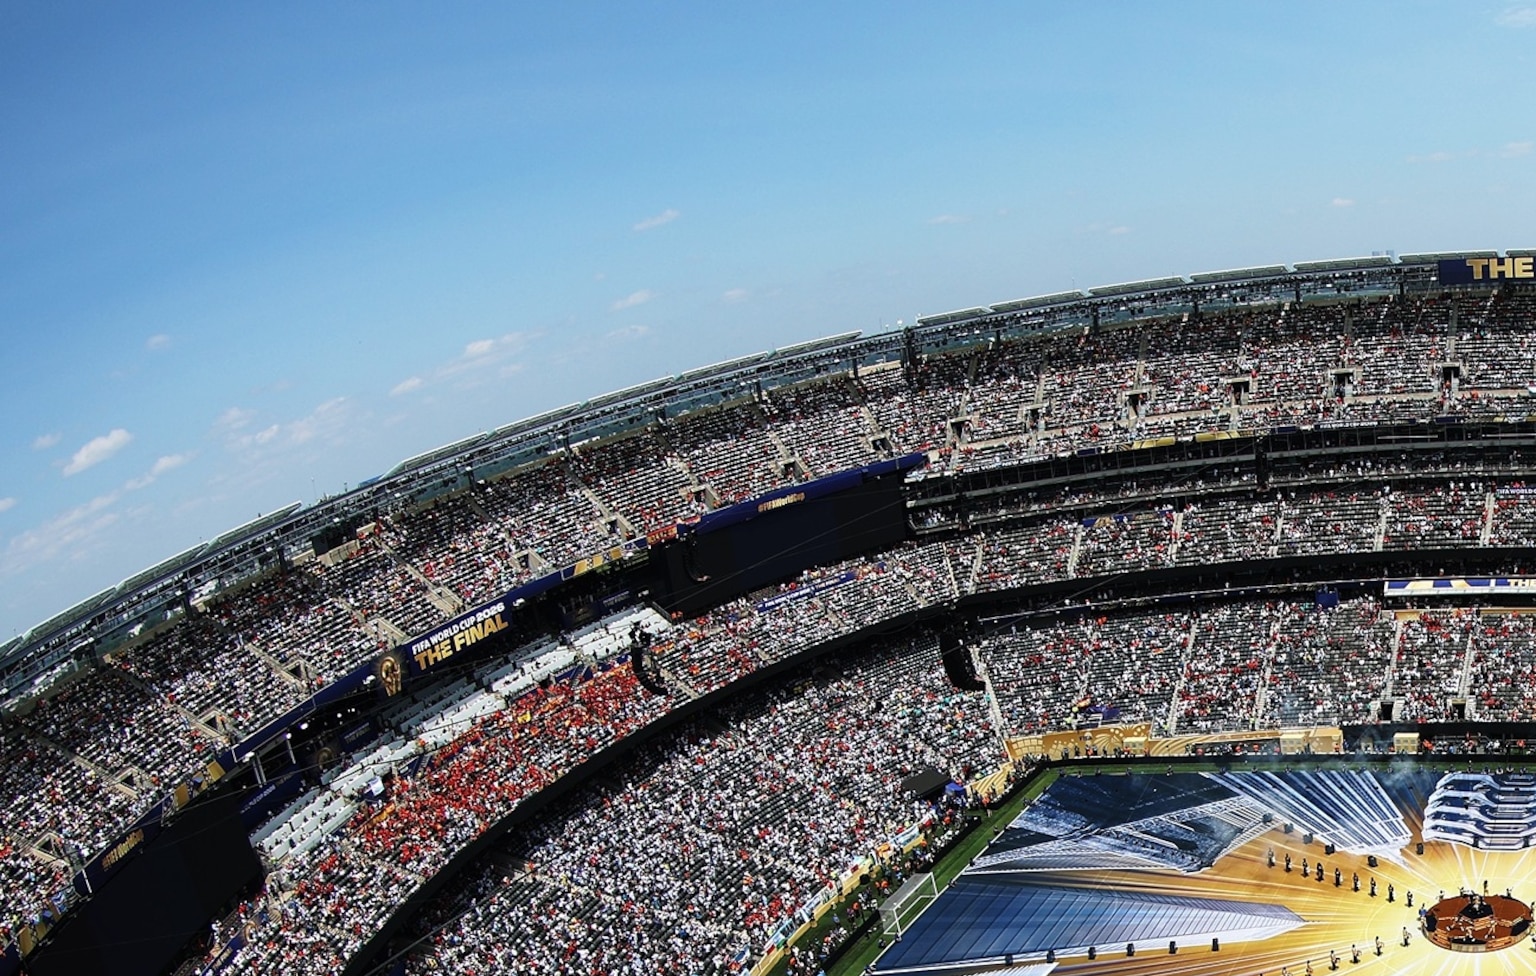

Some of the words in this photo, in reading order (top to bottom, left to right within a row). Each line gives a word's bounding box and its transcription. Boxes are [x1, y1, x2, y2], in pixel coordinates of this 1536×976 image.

[1466, 257, 1534, 280] THE
[412, 640, 431, 655] FIFA
[430, 624, 460, 645] WORLD
[460, 616, 476, 630] CUP
[476, 602, 505, 622] 2026
[414, 639, 453, 670] THE
[454, 613, 508, 651] FINAL
